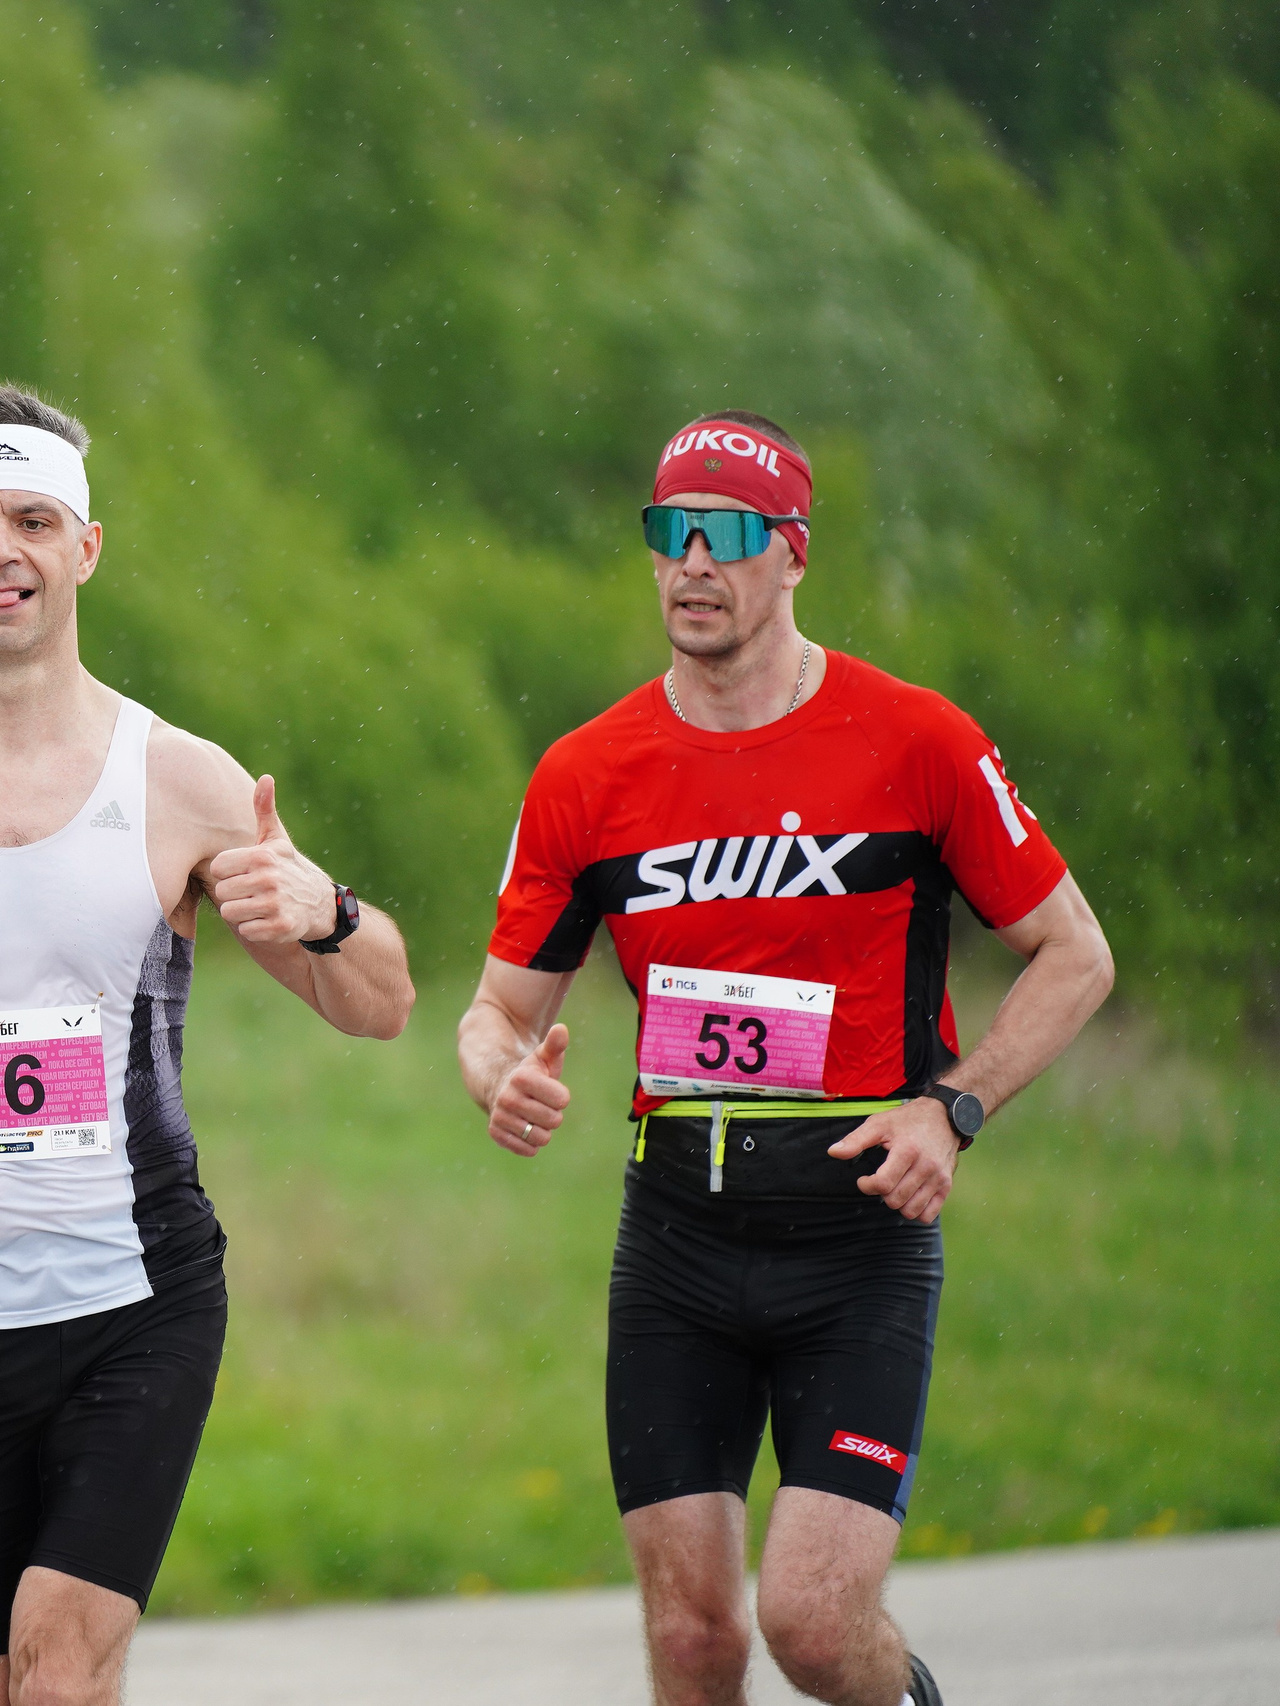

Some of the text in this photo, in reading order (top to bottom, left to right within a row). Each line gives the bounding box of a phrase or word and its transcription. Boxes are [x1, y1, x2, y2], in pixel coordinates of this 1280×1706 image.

[662, 429, 781, 478] LUKOIL
[90, 817, 131, 832] adidas
[675, 980, 698, 990] ПСБ
[695, 1013, 768, 1075] 53
[48, 1060, 65, 1069] ПОКА
[65, 1059, 77, 1068] ВСЕ
[57, 1068, 102, 1080] ПЕРЕЗАГРУЗКА
[54, 1082, 71, 1092] ВСЕМ
[71, 1080, 99, 1090] СЕРДЦЕМ
